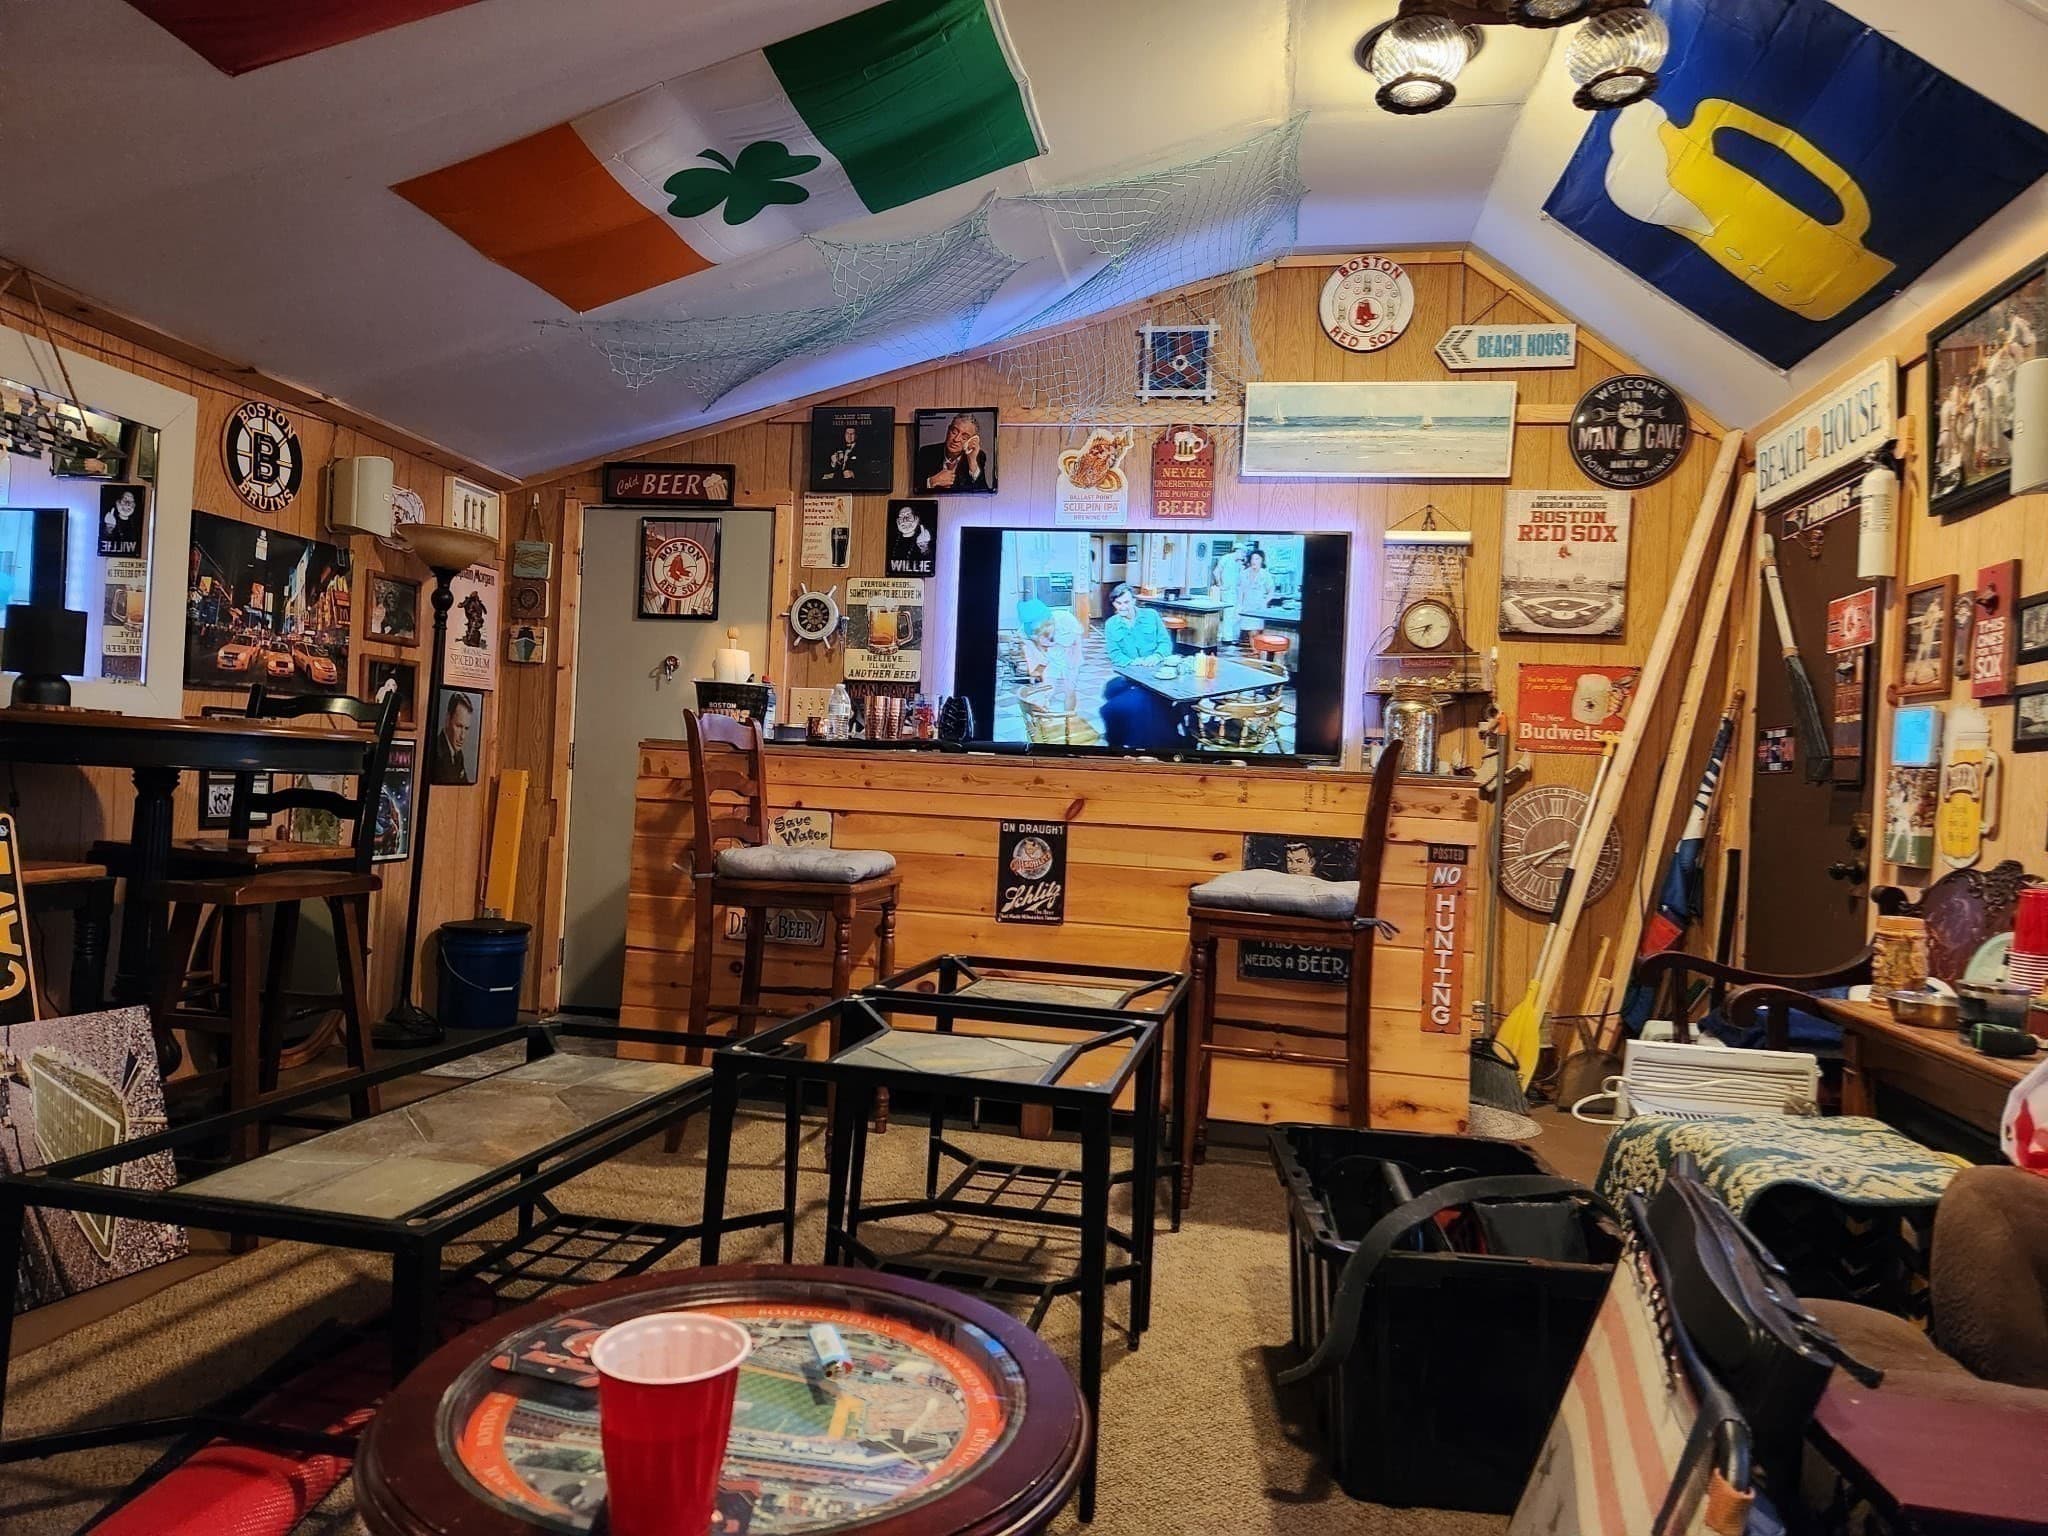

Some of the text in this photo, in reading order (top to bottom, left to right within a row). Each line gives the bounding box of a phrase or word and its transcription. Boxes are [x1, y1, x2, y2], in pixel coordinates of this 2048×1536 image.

[1339, 256, 1403, 280] BOSTON
[1330, 325, 1399, 347] RED SOX
[1478, 333, 1571, 358] BEACH HOUSE
[1595, 379, 1667, 400] WELCOME
[238, 403, 297, 440] BOSTON
[1578, 423, 1684, 450] MAN CAVE
[1760, 382, 1881, 493] BEACH HOUSE
[1162, 467, 1206, 478] NEVER
[1583, 453, 1676, 483] DOING MANLY THINGS
[616, 474, 701, 496] Cold BEER
[1155, 479, 1213, 488] UNDERESTIMATE
[238, 481, 294, 510] BRUINS
[1171, 490, 1199, 498] POWER
[1201, 490, 1212, 498] OF
[1063, 503, 1119, 512] SCULPIN IPA
[1157, 500, 1207, 516] BEER
[1530, 511, 1607, 523] BOSTON
[1517, 525, 1618, 542] RED SOX
[658, 542, 703, 563] BOSTON
[890, 559, 933, 573] WILLIE
[474, 569, 496, 587] Morgan
[660, 579, 701, 595] RED SOX
[861, 580, 890, 588] EVERYONE
[849, 590, 882, 598] SOMETHING
[883, 590, 891, 598] TO
[891, 590, 915, 598] BELIEVE
[1977, 617, 2007, 634] THIS
[848, 670, 918, 679] ANOTHER BEER
[1974, 654, 2004, 680] SOX
[848, 684, 916, 698] MAN CAVE
[774, 815, 812, 834] Save
[1002, 822, 1064, 835] ON DRAUGHT
[780, 828, 829, 846] Water
[1432, 847, 1465, 861] POSTED
[1432, 867, 1462, 885] NO
[1001, 881, 1061, 913] Schlitz
[777, 915, 824, 943] BEER!
[1244, 953, 1349, 978] NEEDS A BEER!
[1431, 893, 1457, 1026] HUNTING
